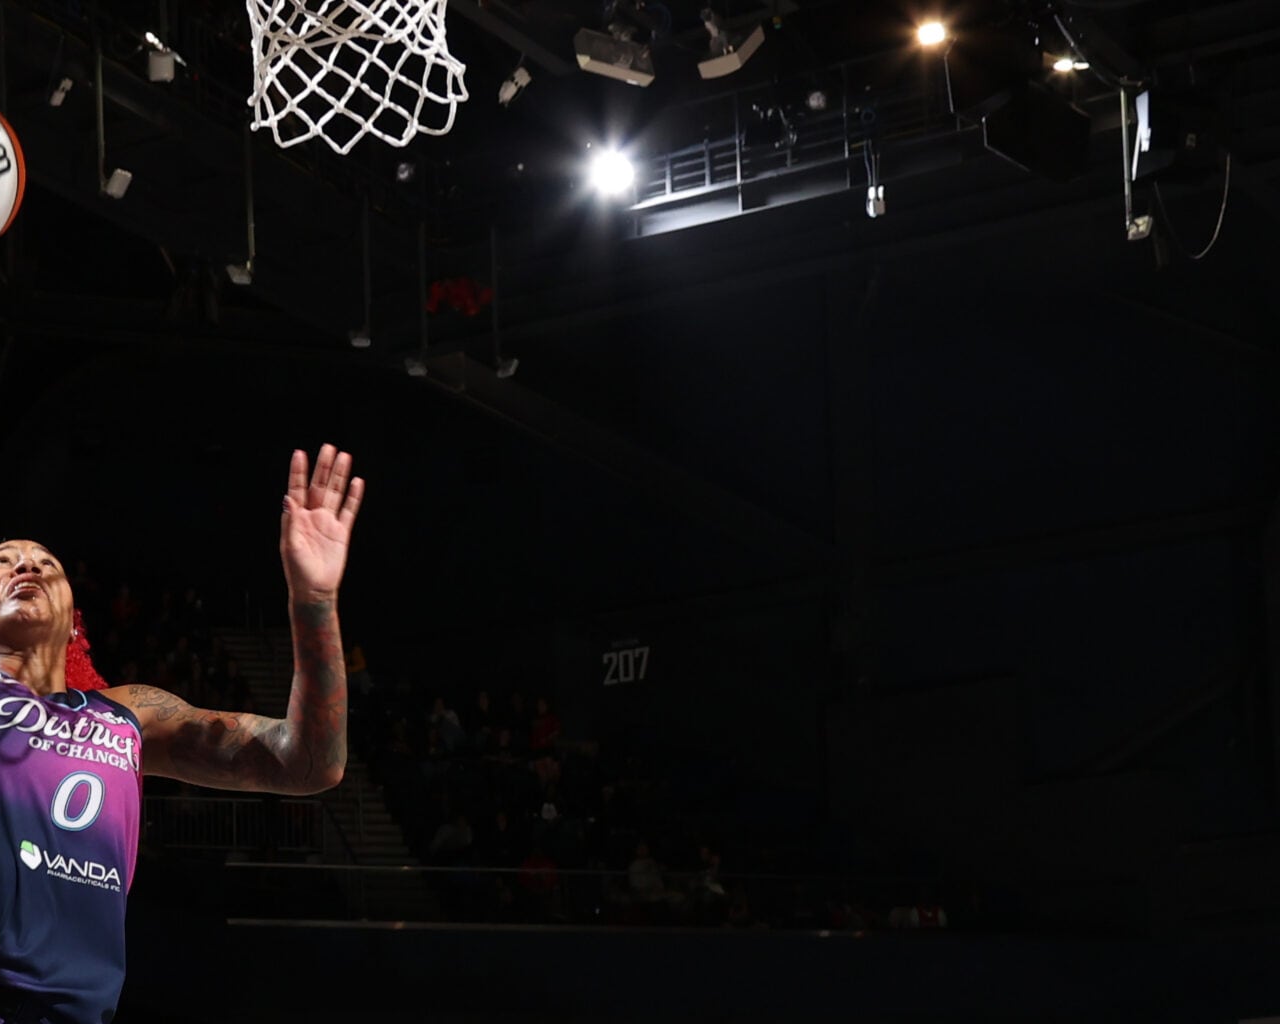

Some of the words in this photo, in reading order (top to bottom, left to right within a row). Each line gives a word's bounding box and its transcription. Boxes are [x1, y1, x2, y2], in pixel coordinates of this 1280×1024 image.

[602, 645, 650, 685] 207
[28, 736, 54, 752] OF
[56, 742, 128, 771] CHANGE
[51, 770, 105, 831] 0
[43, 850, 121, 885] VANDA
